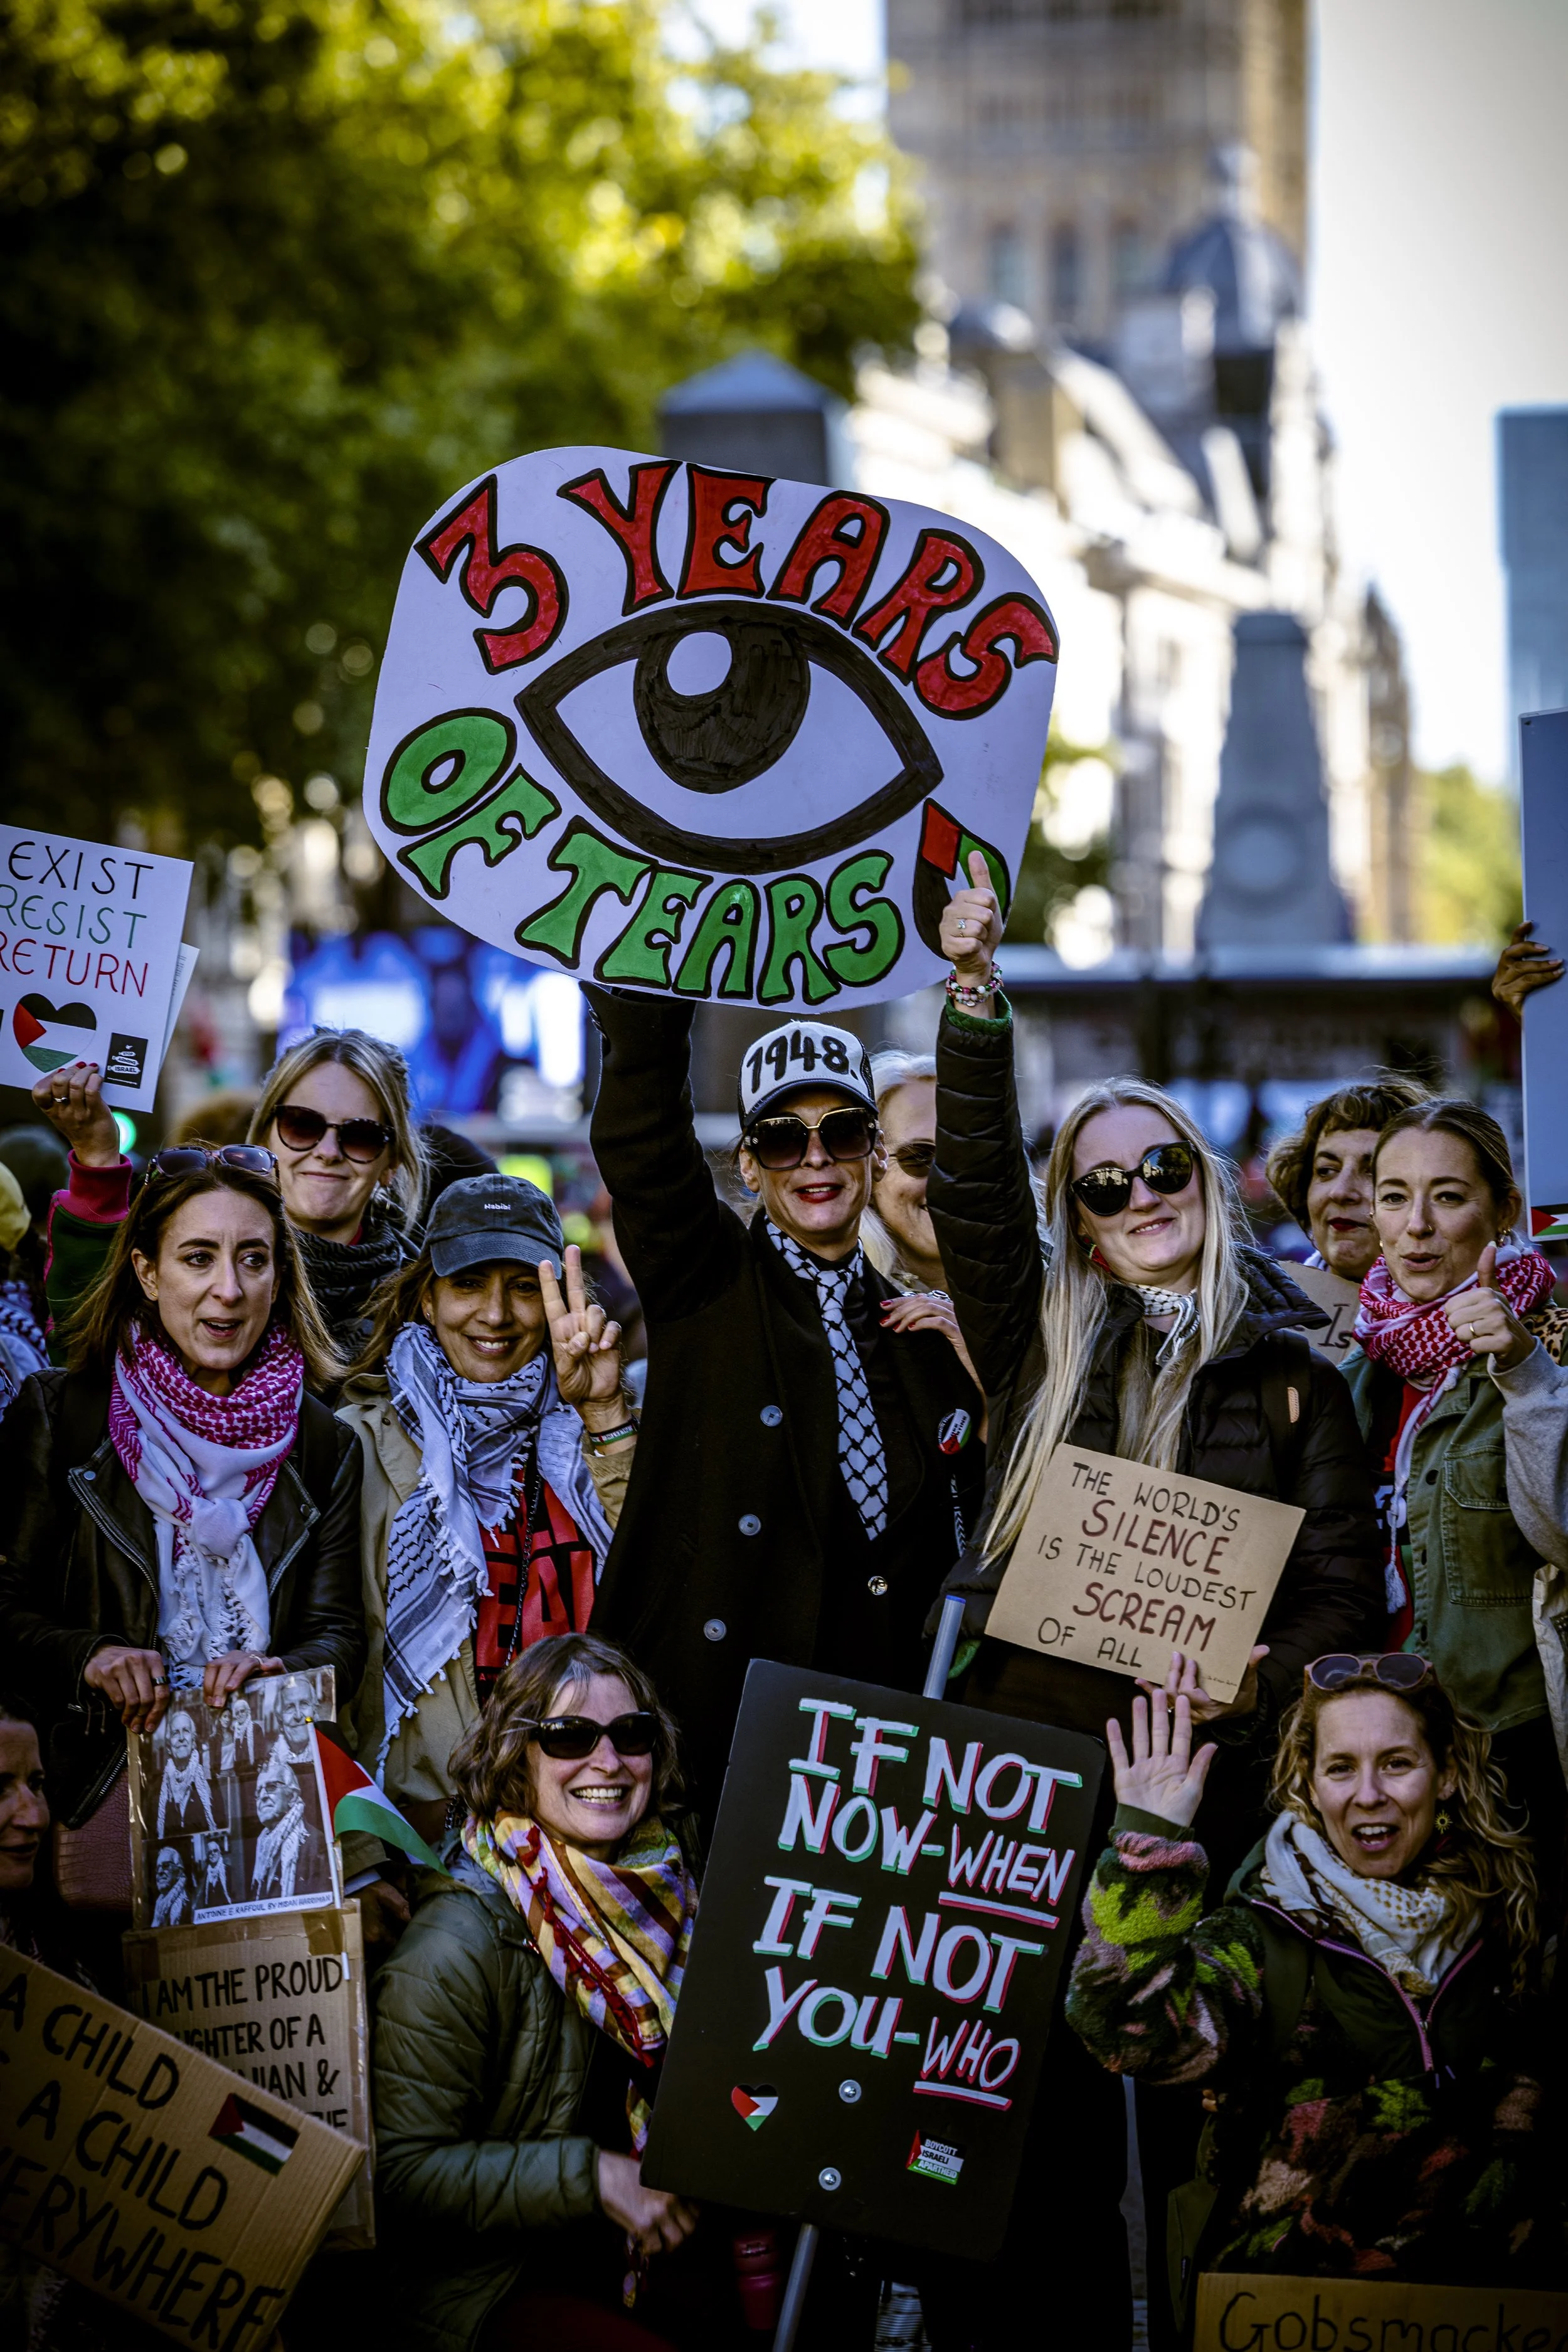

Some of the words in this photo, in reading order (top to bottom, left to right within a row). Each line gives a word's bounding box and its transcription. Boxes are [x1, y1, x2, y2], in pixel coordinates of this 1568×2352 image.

[414, 475, 569, 675] 3
[556, 460, 1060, 721] YEARS
[8, 841, 154, 899] EXIST
[379, 707, 561, 900] OF
[514, 815, 905, 1004] TEARS
[0, 884, 147, 948] RESIST
[1071, 1462, 1113, 1496] THE
[1133, 1482, 1240, 1532] WORLD'S
[1082, 1499, 1230, 1575] SILENCE
[1037, 1534, 1062, 1559] IS
[1076, 1544, 1121, 1574] THE
[1134, 1562, 1256, 1611] LOUDEST
[1038, 1617, 1076, 1646] OF
[1097, 1637, 1142, 1668] ALL
[1073, 1582, 1216, 1651] SCREAM
[788, 1698, 919, 1796] IF
[923, 1736, 1082, 1833] NOT
[196, 1909, 226, 1920] ANTOINE
[235, 1904, 266, 1914] RAFFOUL
[278, 1900, 299, 1908] MISAN
[753, 1875, 861, 1960] IF
[871, 1905, 1044, 2013] NOT
[141, 1982, 151, 2018] I
[156, 1976, 193, 2017] AM
[194, 1968, 248, 2007] THE
[255, 1957, 343, 2001] PROUD
[43, 2004, 179, 2110] CHILD
[270, 2016, 301, 2050] OF
[307, 2014, 325, 2047] A
[317, 2059, 340, 2097] &
[17, 2080, 61, 2141] A
[76, 2111, 228, 2230] CHILD
[918, 2160, 957, 2178] APARTHEID
[922, 2149, 950, 2164] ISRAELI
[924, 2138, 958, 2156] BOYCOTT
[0, 2147, 285, 2352] ERYWHERE
